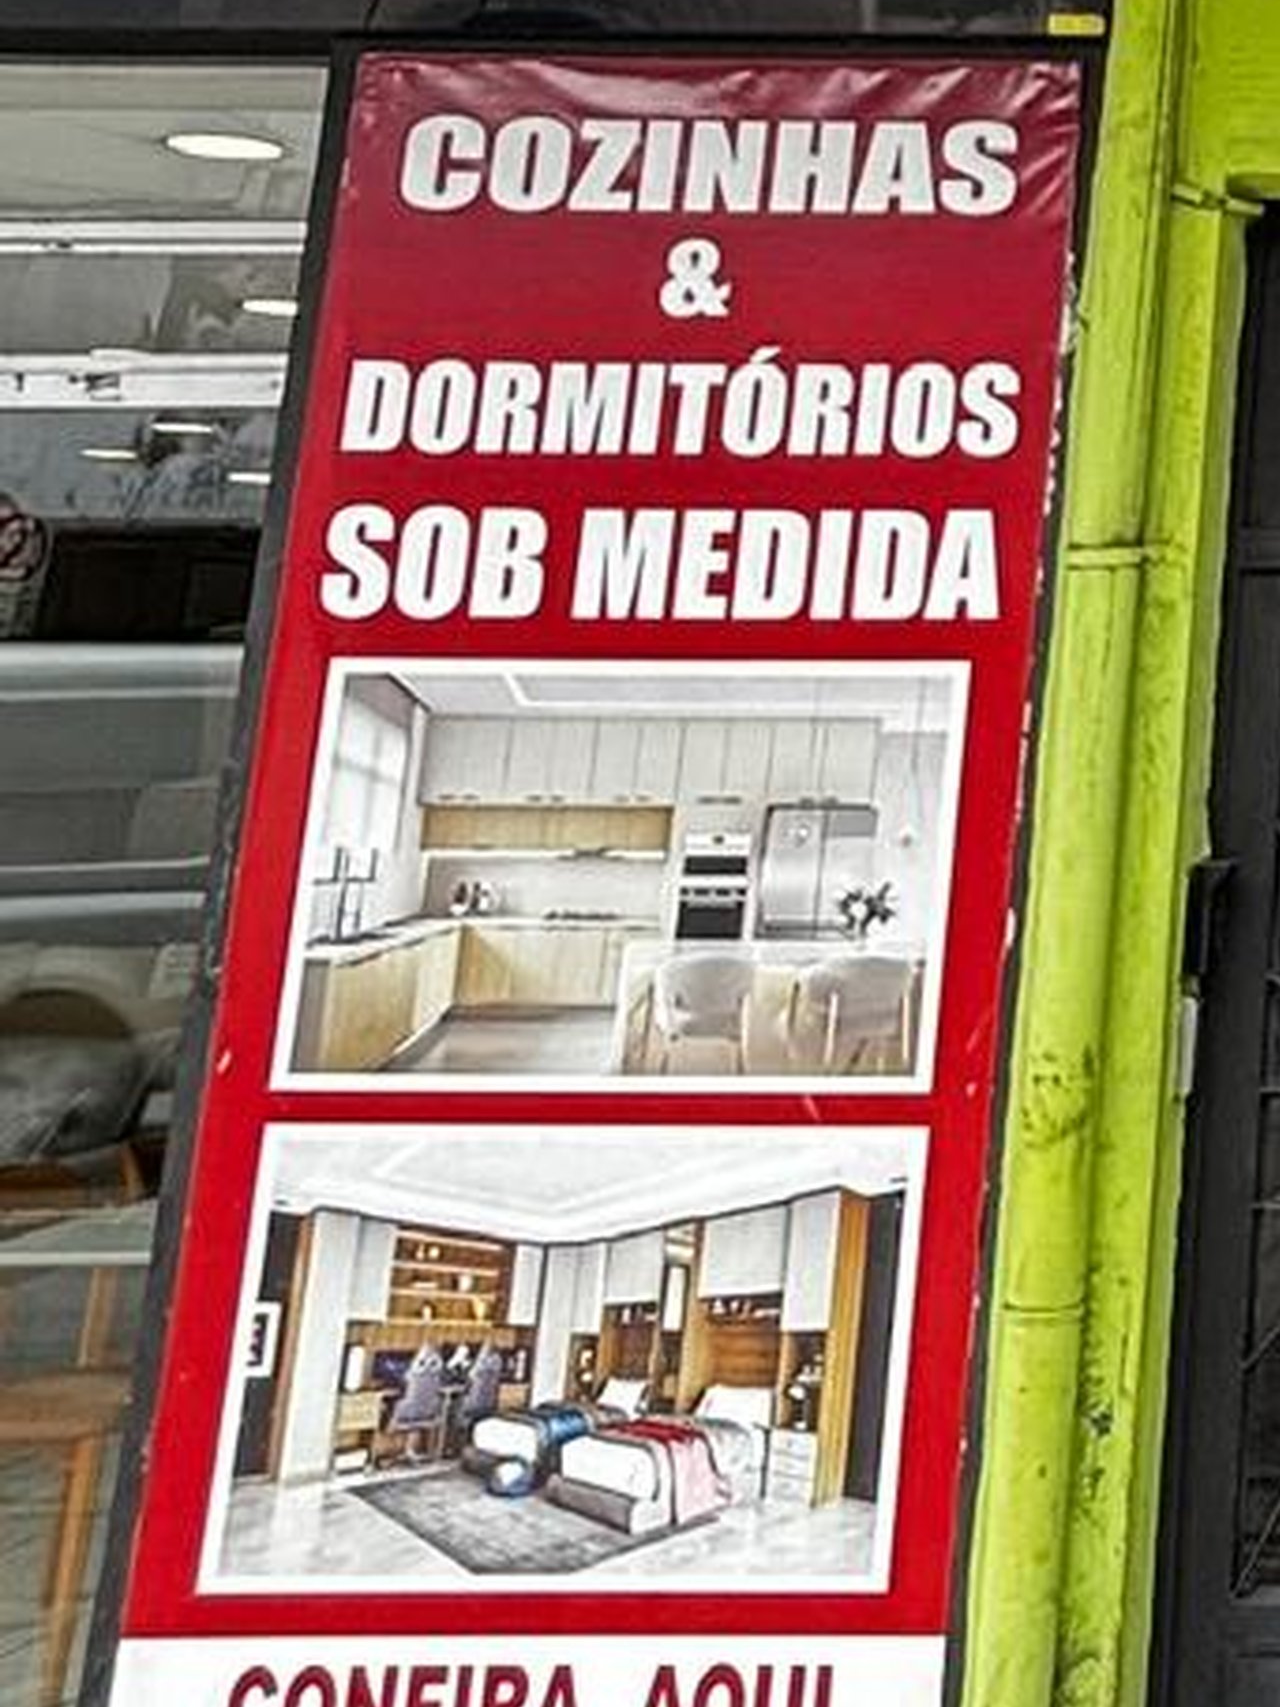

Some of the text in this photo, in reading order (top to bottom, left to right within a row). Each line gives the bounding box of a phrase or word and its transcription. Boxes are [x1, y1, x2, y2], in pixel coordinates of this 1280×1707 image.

[399, 114, 1021, 217] COZINHAS
[658, 237, 733, 320] &
[340, 346, 1022, 458] DORMITÓRIOS
[319, 502, 1002, 622] SOB MEDIDA
